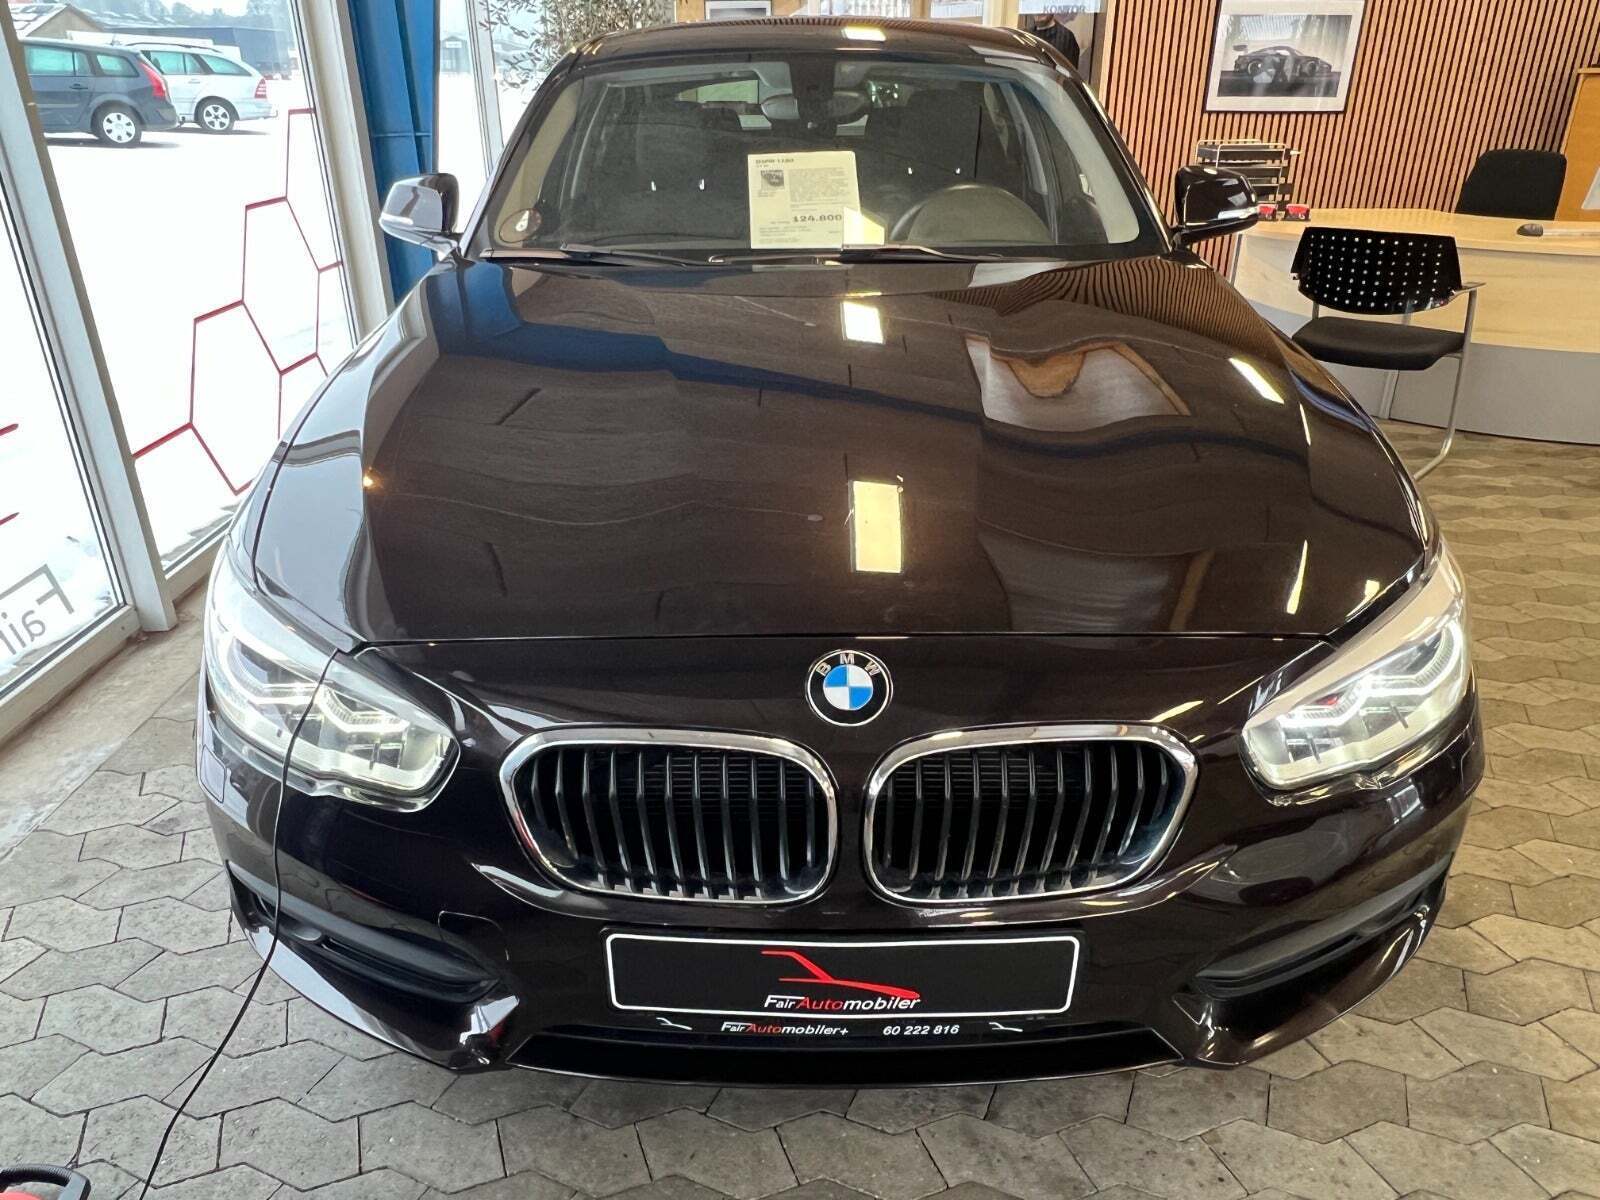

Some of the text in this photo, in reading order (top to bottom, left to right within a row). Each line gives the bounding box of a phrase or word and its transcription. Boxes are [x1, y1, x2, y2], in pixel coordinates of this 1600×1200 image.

[1043, 5, 1086, 14] KONTOR
[816, 653, 880, 676] BMW
[764, 995, 920, 1010] FairAutomobiler
[882, 1025, 901, 1035] 60
[903, 1025, 930, 1035] 222
[933, 1024, 960, 1034] 816
